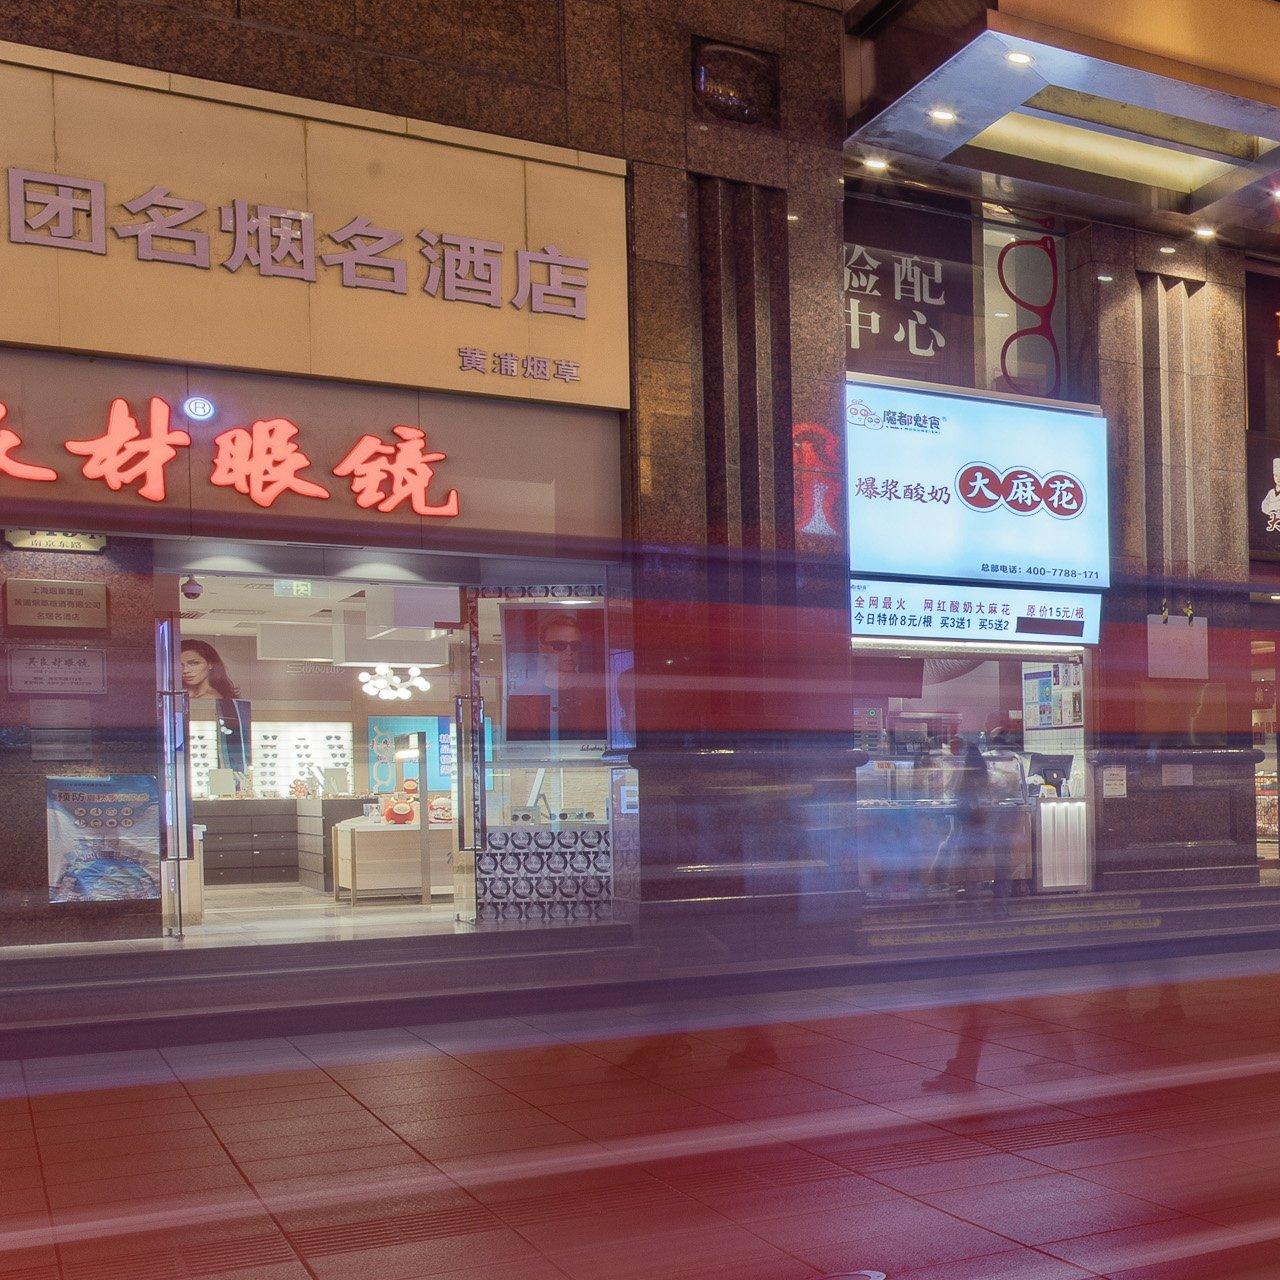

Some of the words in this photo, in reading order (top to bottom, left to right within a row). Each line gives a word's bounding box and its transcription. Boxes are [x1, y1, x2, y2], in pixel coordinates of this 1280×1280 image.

[8, 166, 590, 319] 团名烟名酒店
[845, 298, 946, 357] 中心
[458, 346, 582, 384] 黄浦烟草
[854, 476, 951, 506] 爆浆酸奶
[967, 472, 1078, 511] 大麻花
[853, 613, 933, 629] 今日特价8元/根
[940, 616, 971, 629] 买3送1
[978, 618, 1010, 632] 买5送2
[854, 595, 906, 611] 全网最火
[923, 598, 1011, 616] 网红酸奶大麻花
[1026, 604, 1084, 620] 原价15元/根
